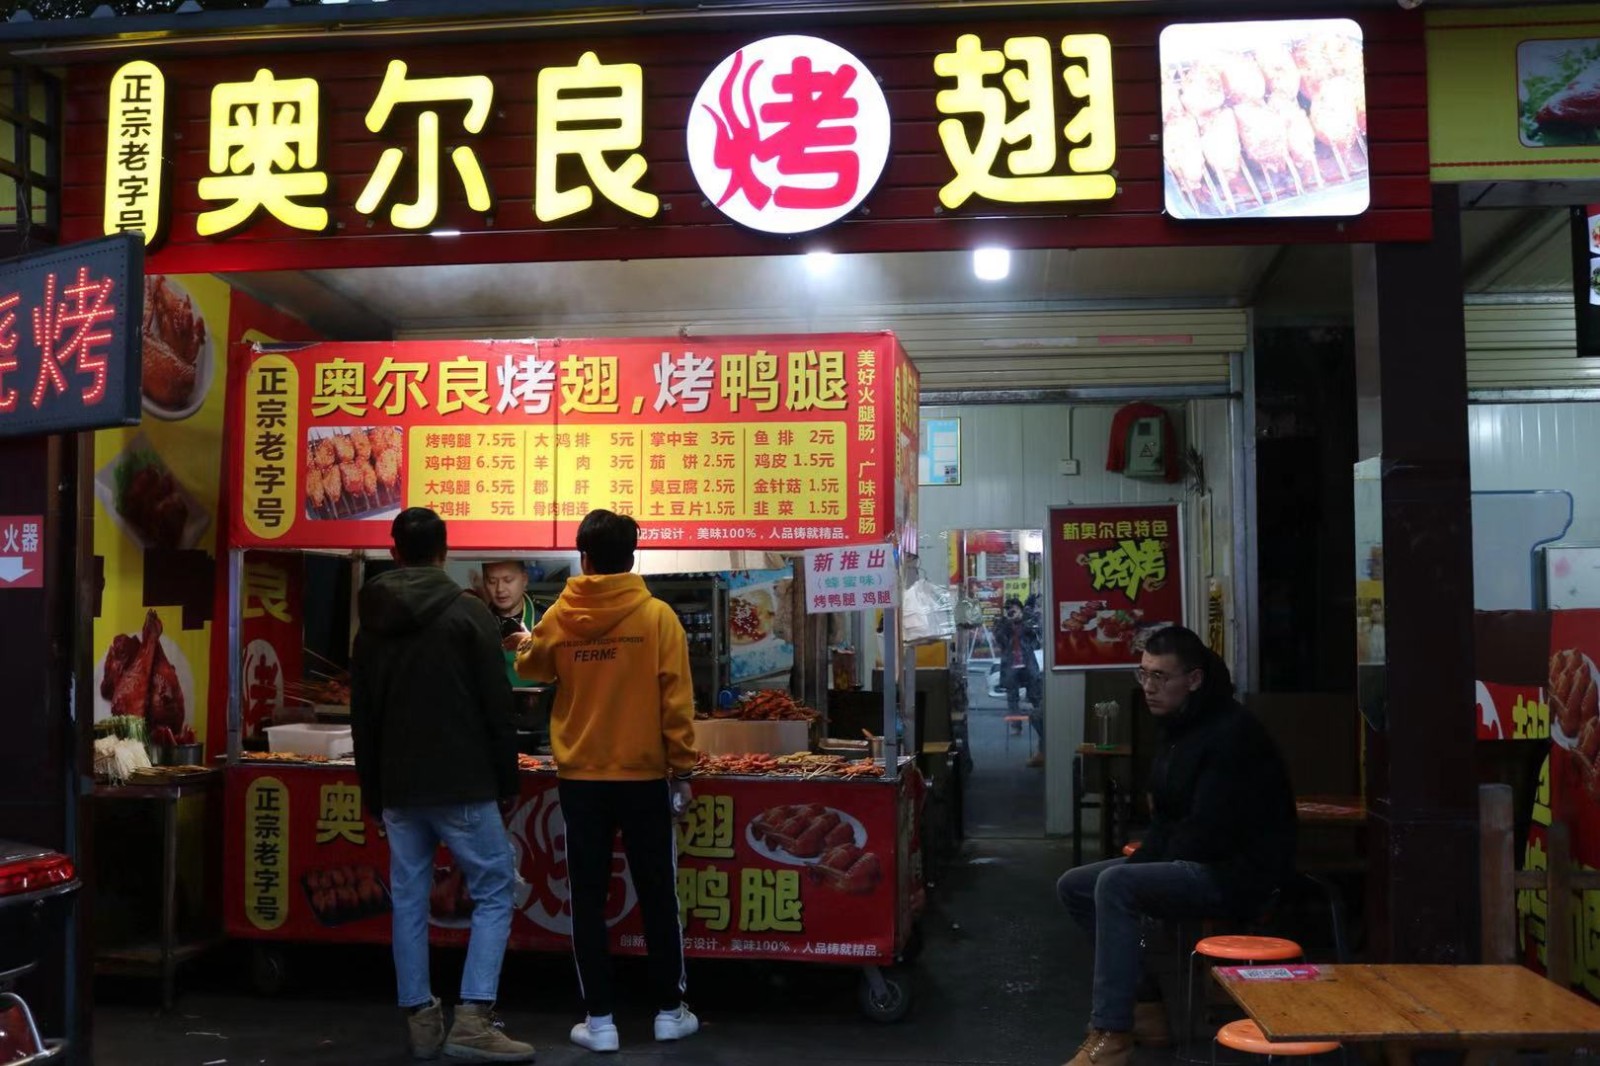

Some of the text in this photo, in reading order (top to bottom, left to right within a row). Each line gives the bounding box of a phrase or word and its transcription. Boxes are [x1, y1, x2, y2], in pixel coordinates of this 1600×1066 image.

[197, 34, 1116, 236] 奥尔良烤翅
[115, 75, 152, 233] 正宗老字号
[425, 433, 515, 448] 烤鸭腿 7.5元
[611, 432, 634, 447] 5元
[651, 431, 735, 447] 掌中宝 3元
[809, 430, 834, 444] 2元
[253, 367, 287, 527] 正宗老字号
[425, 456, 515, 470] 鸡中翅 6.5元
[610, 455, 634, 469] 3元
[703, 454, 735, 468] 2.5元
[754, 453, 834, 468] 鸡皮 1.5元
[425, 480, 515, 495] 大鸡腿 6.5元
[610, 480, 634, 494] 3元
[650, 479, 735, 494] 臭豆腐 2.5元
[754, 478, 839, 494] 金针菇 1.5元
[491, 501, 514, 515] 5元
[533, 501, 633, 516] 骨肉相连 3元
[705, 500, 735, 515] 1.5元
[809, 500, 839, 515] 1.5元
[1062, 519, 1169, 541] 新奥尔良特色
[813, 549, 885, 572] 新推出
[1087, 538, 1167, 601] 烧烤
[814, 591, 891, 608] 烤鸭腿 鸡腿
[573, 647, 618, 663] FERME
[254, 787, 280, 921] 正宗老字号
